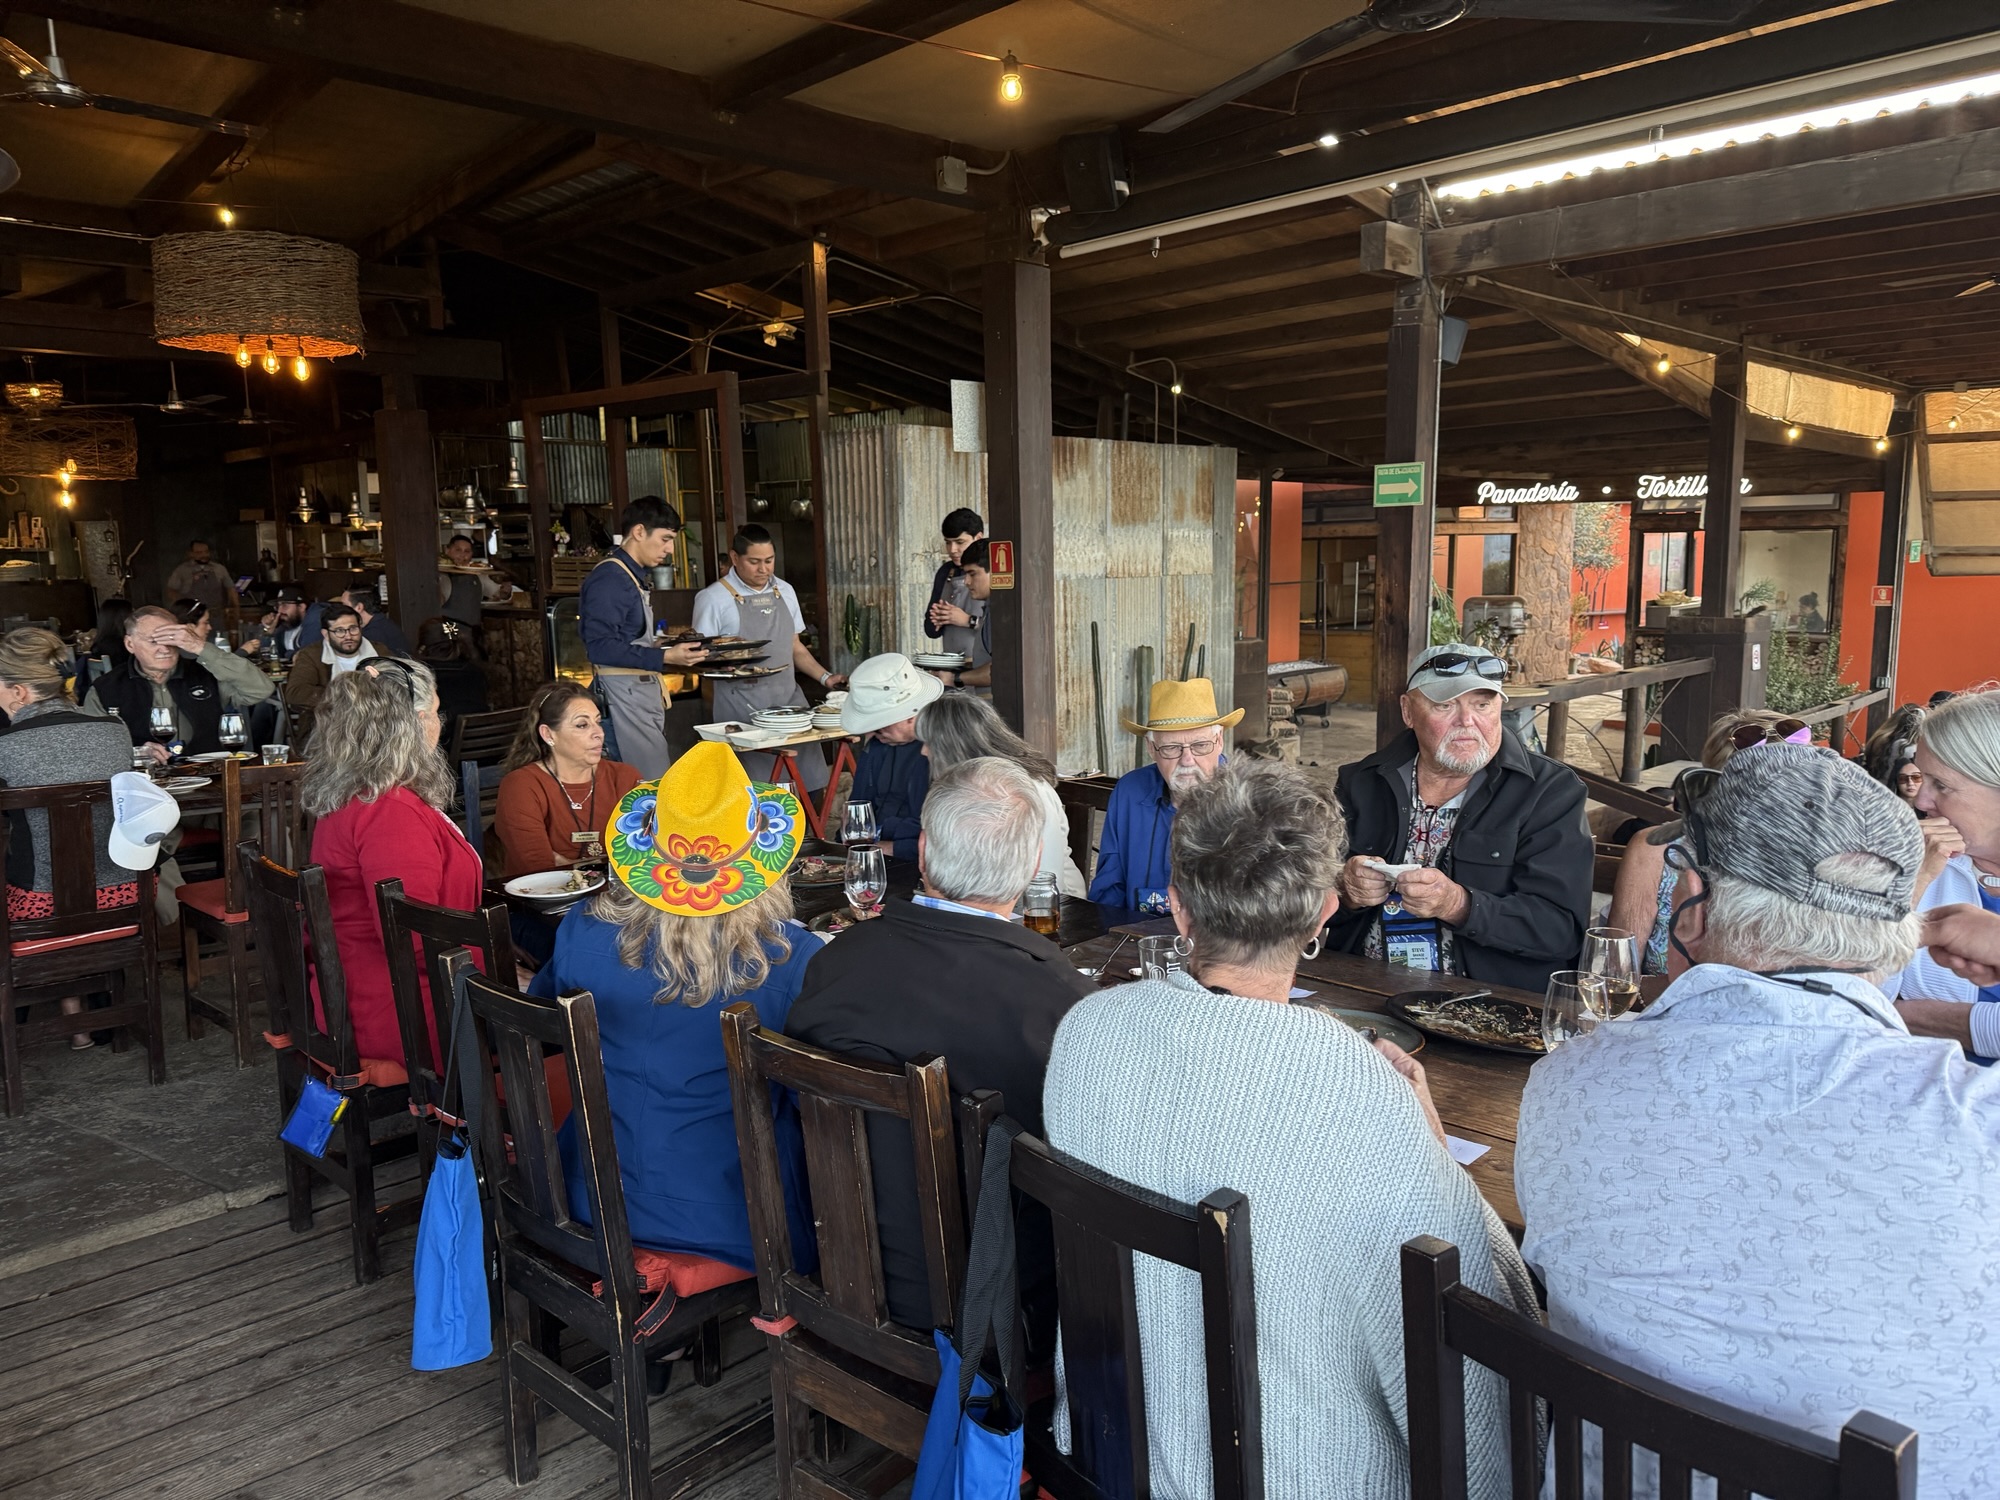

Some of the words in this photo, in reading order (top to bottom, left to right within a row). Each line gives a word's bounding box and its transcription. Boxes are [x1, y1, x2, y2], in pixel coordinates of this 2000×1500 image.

[1477, 481, 1580, 504] Panadería
[1636, 474, 1753, 499] Tortilla
[992, 576, 1012, 585] EXTINTOR
